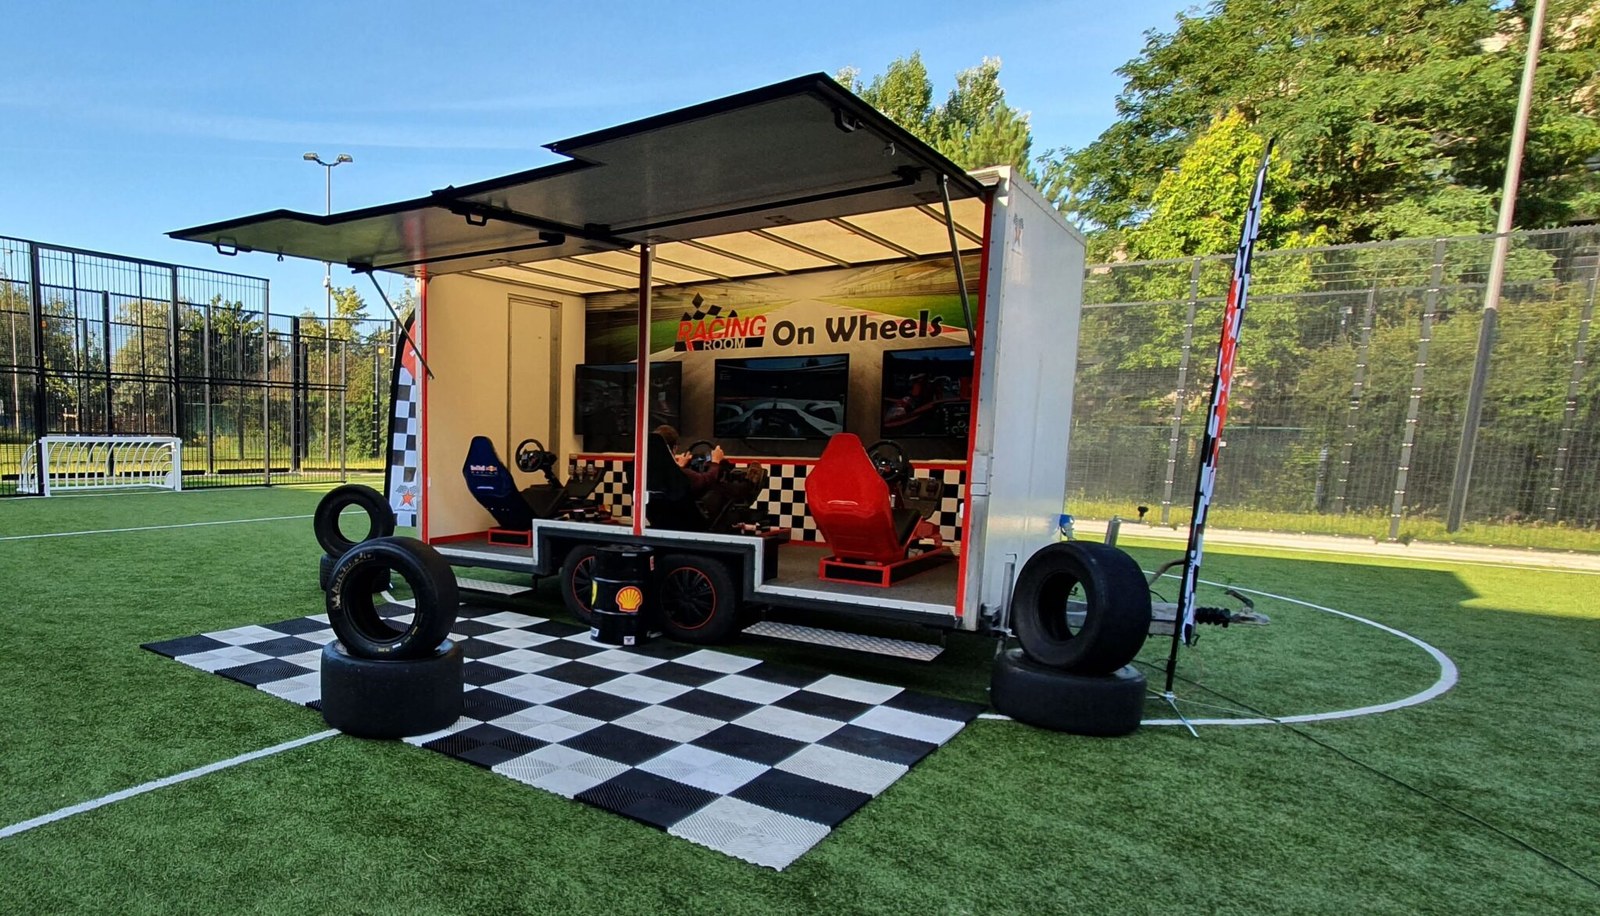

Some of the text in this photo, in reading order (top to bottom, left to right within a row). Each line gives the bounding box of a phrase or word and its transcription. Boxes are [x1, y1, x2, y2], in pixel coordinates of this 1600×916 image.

[677, 315, 767, 352] RACING
[703, 338, 745, 351] ROOM
[772, 310, 943, 346] On Wheels
